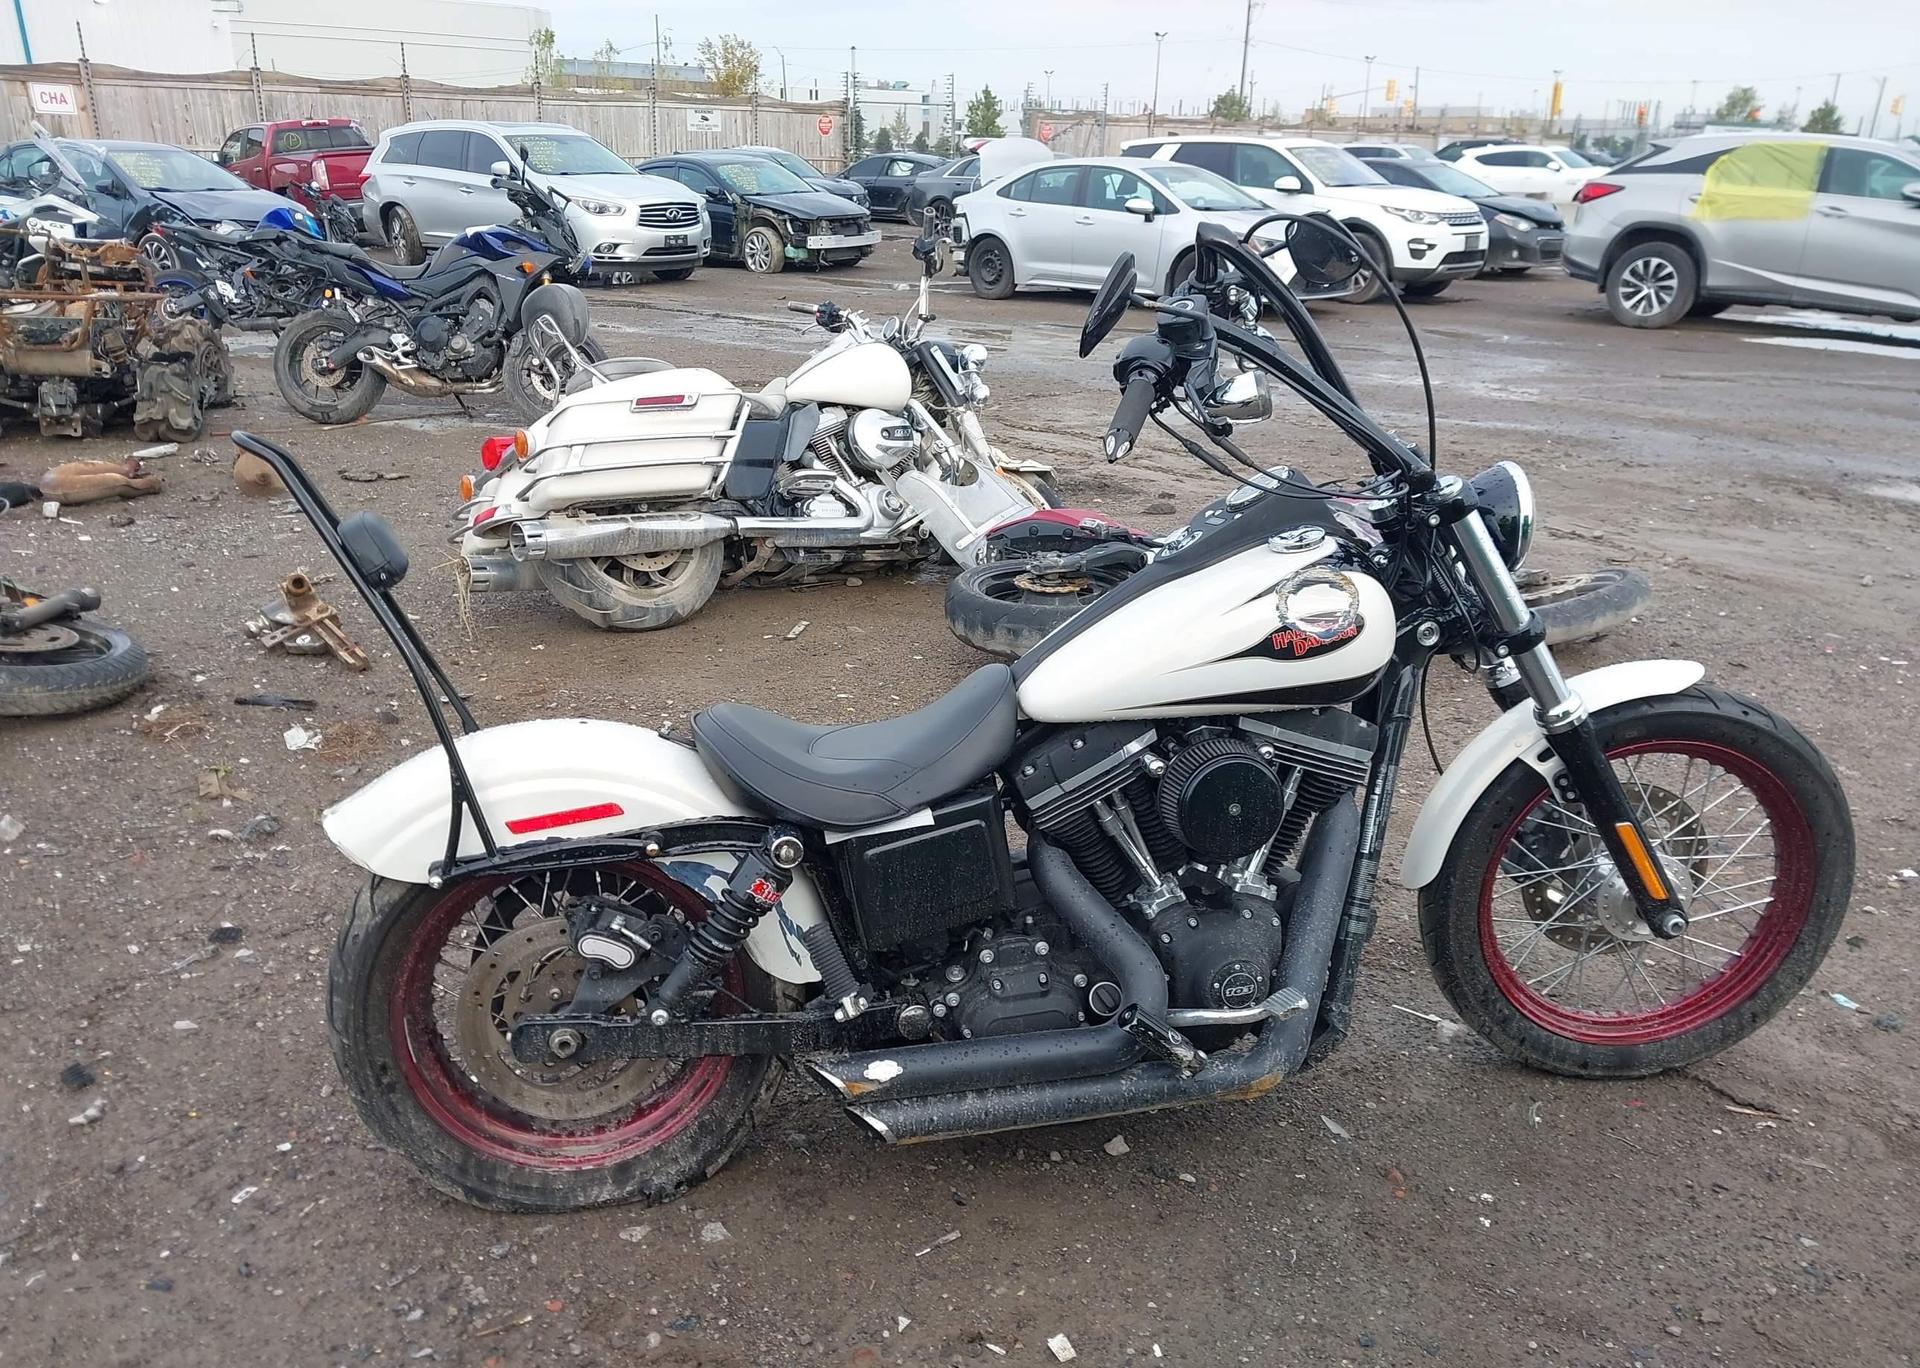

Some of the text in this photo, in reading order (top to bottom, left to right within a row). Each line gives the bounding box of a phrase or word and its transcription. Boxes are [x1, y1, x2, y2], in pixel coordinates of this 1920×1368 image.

[40, 91, 69, 105] CHA
[1272, 628, 1307, 650] HAR
[1225, 984, 1255, 997] 103
